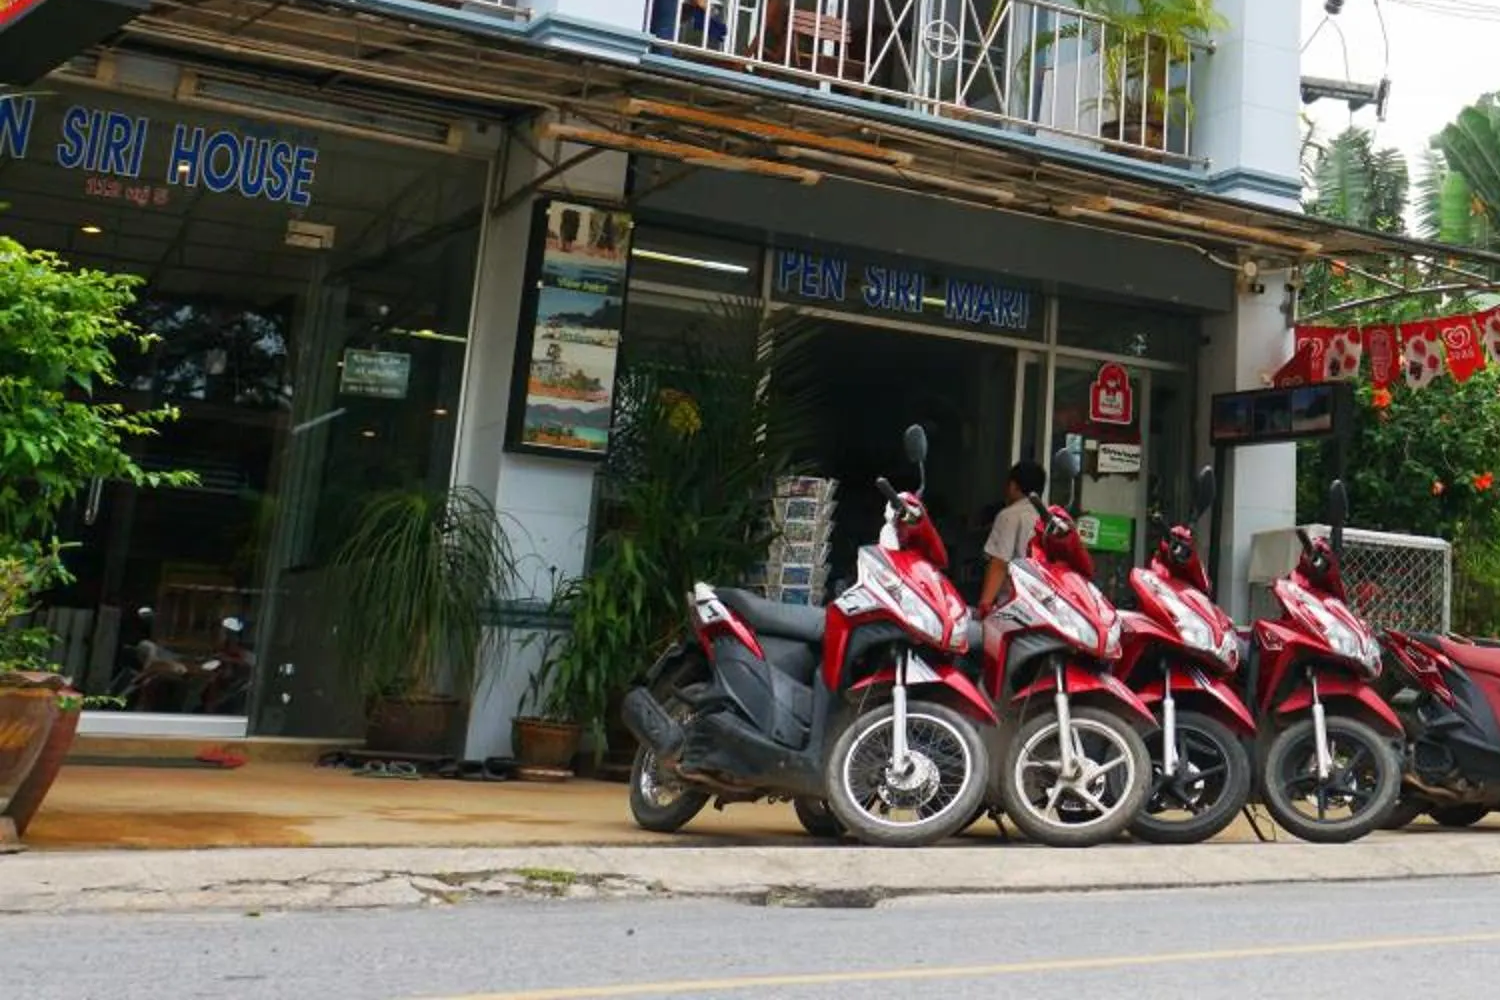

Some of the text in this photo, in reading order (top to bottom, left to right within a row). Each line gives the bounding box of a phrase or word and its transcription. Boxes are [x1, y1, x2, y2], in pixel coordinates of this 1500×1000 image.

[57, 106, 149, 178] SIRI
[168, 123, 319, 206] HOUSE
[779, 250, 1030, 330] PEN SIRI MART
